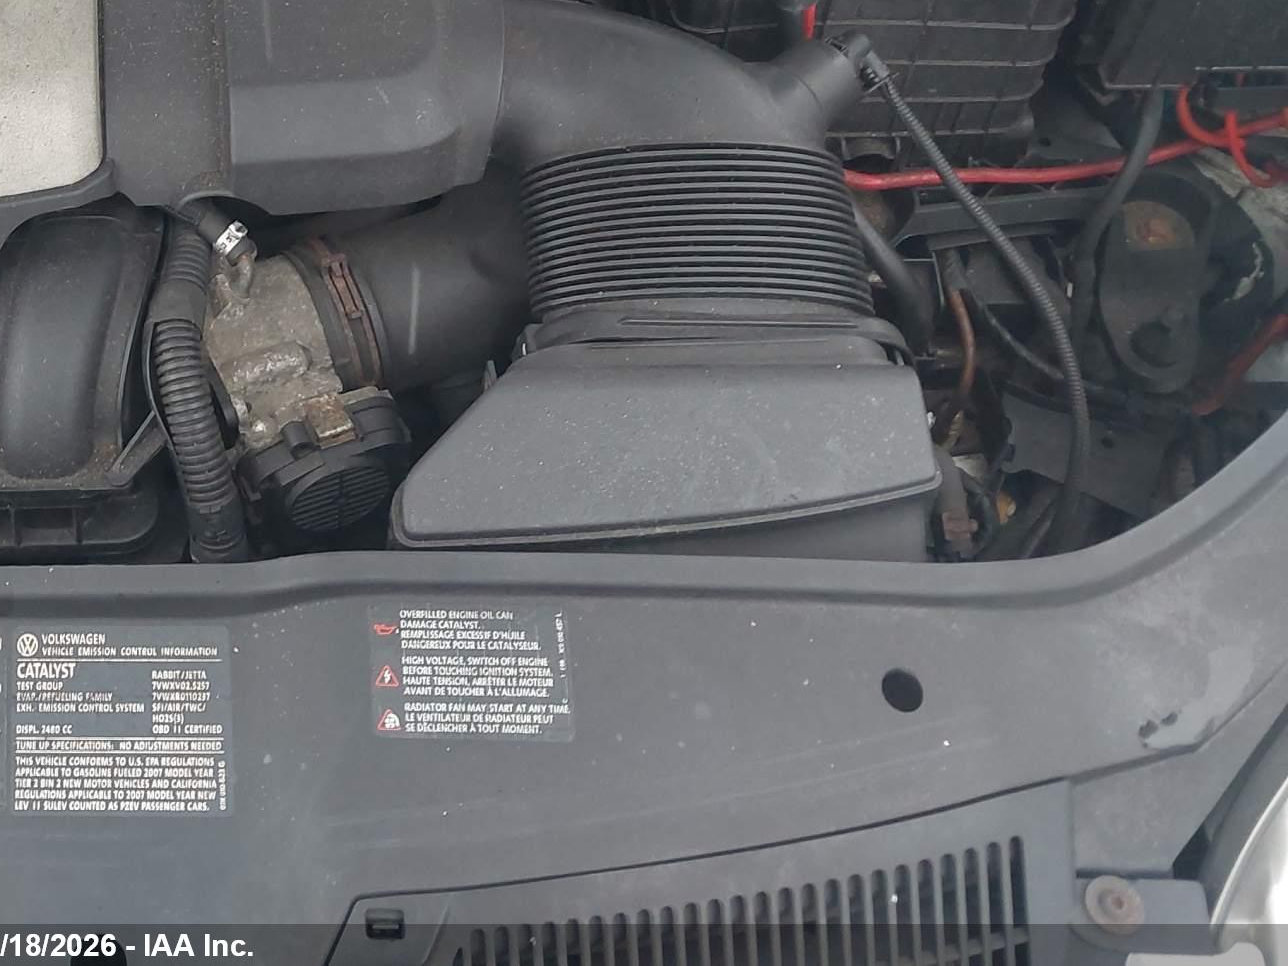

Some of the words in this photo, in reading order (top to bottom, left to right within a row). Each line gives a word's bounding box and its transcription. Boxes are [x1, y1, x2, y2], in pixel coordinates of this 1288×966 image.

[448, 611, 478, 619] ENGINE
[480, 611, 494, 619] OIL
[496, 611, 513, 619] CAN
[42, 634, 106, 644] VOLKSWAGEN
[456, 631, 490, 639] EXCESSIF
[493, 631, 525, 640] D'HUILE
[401, 641, 451, 649] DANGEREUX
[452, 641, 475, 649] POUR
[42, 648, 74, 656] VEHICLE
[78, 648, 116, 656] EMISSION
[121, 648, 156, 656] CONTROL
[161, 648, 217, 656] INFORMATION
[518, 658, 548, 666] ENGINE
[17, 663, 76, 678] CATALYST
[434, 667, 477, 675] TOUCHING
[480, 667, 517, 676] IGNITION
[508, 678, 517, 686] LE
[519, 678, 553, 687] MOTEUR
[404, 687, 433, 695] AVANT
[447, 688, 484, 696] TOUCHER
[487, 686, 493, 696] À
[39, 704, 76, 712] EMISSION
[78, 704, 114, 712] CONTROL
[115, 704, 145, 712] SYSTEM
[405, 703, 447, 711] RADIATOR
[449, 704, 465, 712] FAN
[468, 704, 487, 712] MAY
[489, 704, 513, 712] START
[516, 704, 526, 712] AT
[529, 704, 546, 713] ANY
[417, 714, 470, 722] VENTILATEUR
[485, 715, 531, 723] RADIATEUR
[62, 725, 72, 734] CC
[153, 725, 169, 734] OBD
[184, 725, 222, 734] CERTIFIED
[470, 723, 476, 732] À
[478, 725, 499, 733] TOUT
[16, 742, 36, 750] TUNE
[39, 742, 49, 750] UP
[120, 742, 131, 750] NO
[134, 742, 189, 750] ADJUSTMENTS
[191, 742, 221, 750] NEEDED
[16, 757, 33, 766] THIS
[35, 757, 67, 766] VEHICLE
[69, 757, 113, 766] CONFORMS
[116, 757, 126, 766] TO
[146, 757, 159, 766] EPA
[161, 757, 214, 766] REGULATIONS
[16, 769, 59, 777] APPLICABLE
[61, 769, 71, 777] TO
[74, 769, 111, 777] GASOLINE
[114, 769, 141, 777] FUELED
[144, 769, 163, 777] 2007
[165, 769, 192, 777] MODEL
[195, 769, 213, 777] YEAR
[16, 780, 31, 788] TIER
[33, 780, 38, 788] 2
[41, 780, 54, 788] BIN
[56, 780, 61, 788] 2
[63, 780, 82, 788] NEW
[84, 780, 112, 788] MOTOR
[115, 780, 150, 788] VEHICLES
[152, 780, 169, 788] AND
[172, 780, 216, 788] CALIFORNIA
[15, 791, 66, 799] REGULATIONS
[69, 791, 111, 799] APPLICABLE
[114, 791, 124, 799] TO
[126, 791, 145, 799] 2007
[147, 791, 174, 799] MODEL
[176, 791, 195, 799] YEAR
[197, 791, 216, 799] NEW
[15, 802, 28, 810] LEV
[44, 802, 67, 810] SULEV
[69, 802, 106, 810] COUNTED
[108, 802, 118, 810] AS
[121, 802, 139, 810] PZEV
[141, 802, 185, 810] PASSENGER
